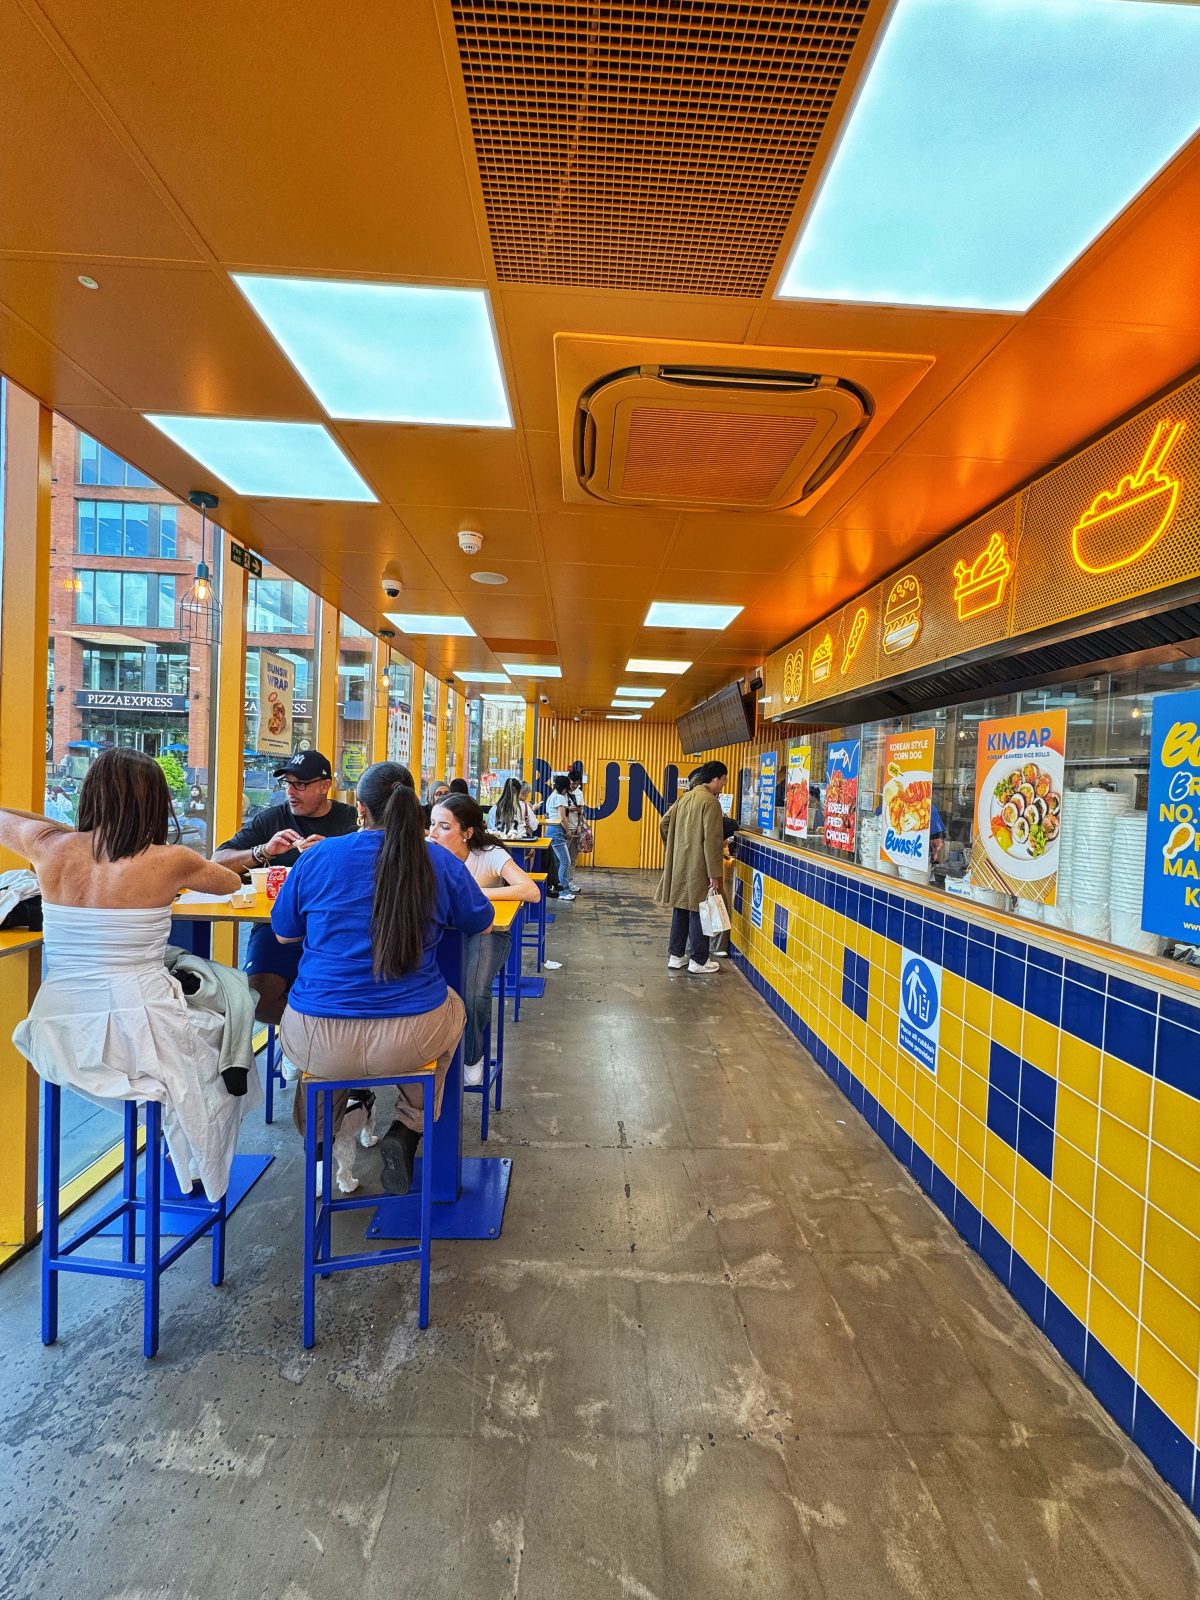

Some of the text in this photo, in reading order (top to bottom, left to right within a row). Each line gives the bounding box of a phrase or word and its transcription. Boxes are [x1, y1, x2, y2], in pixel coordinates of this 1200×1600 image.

[267, 662, 288, 678] BUNSIK
[267, 674, 289, 691] WRAP
[87, 694, 174, 708] PIZZAEXPRESS
[890, 740, 928, 752] KOREAN STYLE
[987, 727, 1052, 751] KIMBAP
[894, 751, 921, 760] CORN DOG
[828, 802, 849, 815] KOREAN
[827, 816, 843, 828] FRIED
[826, 829, 850, 844] CHICKEN
[885, 828, 923, 858] Bunsik
[1163, 857, 1200, 880] MA
[1184, 886, 1200, 909] K
[917, 1037, 935, 1055] rubbish
[914, 1045, 934, 1064] provided
